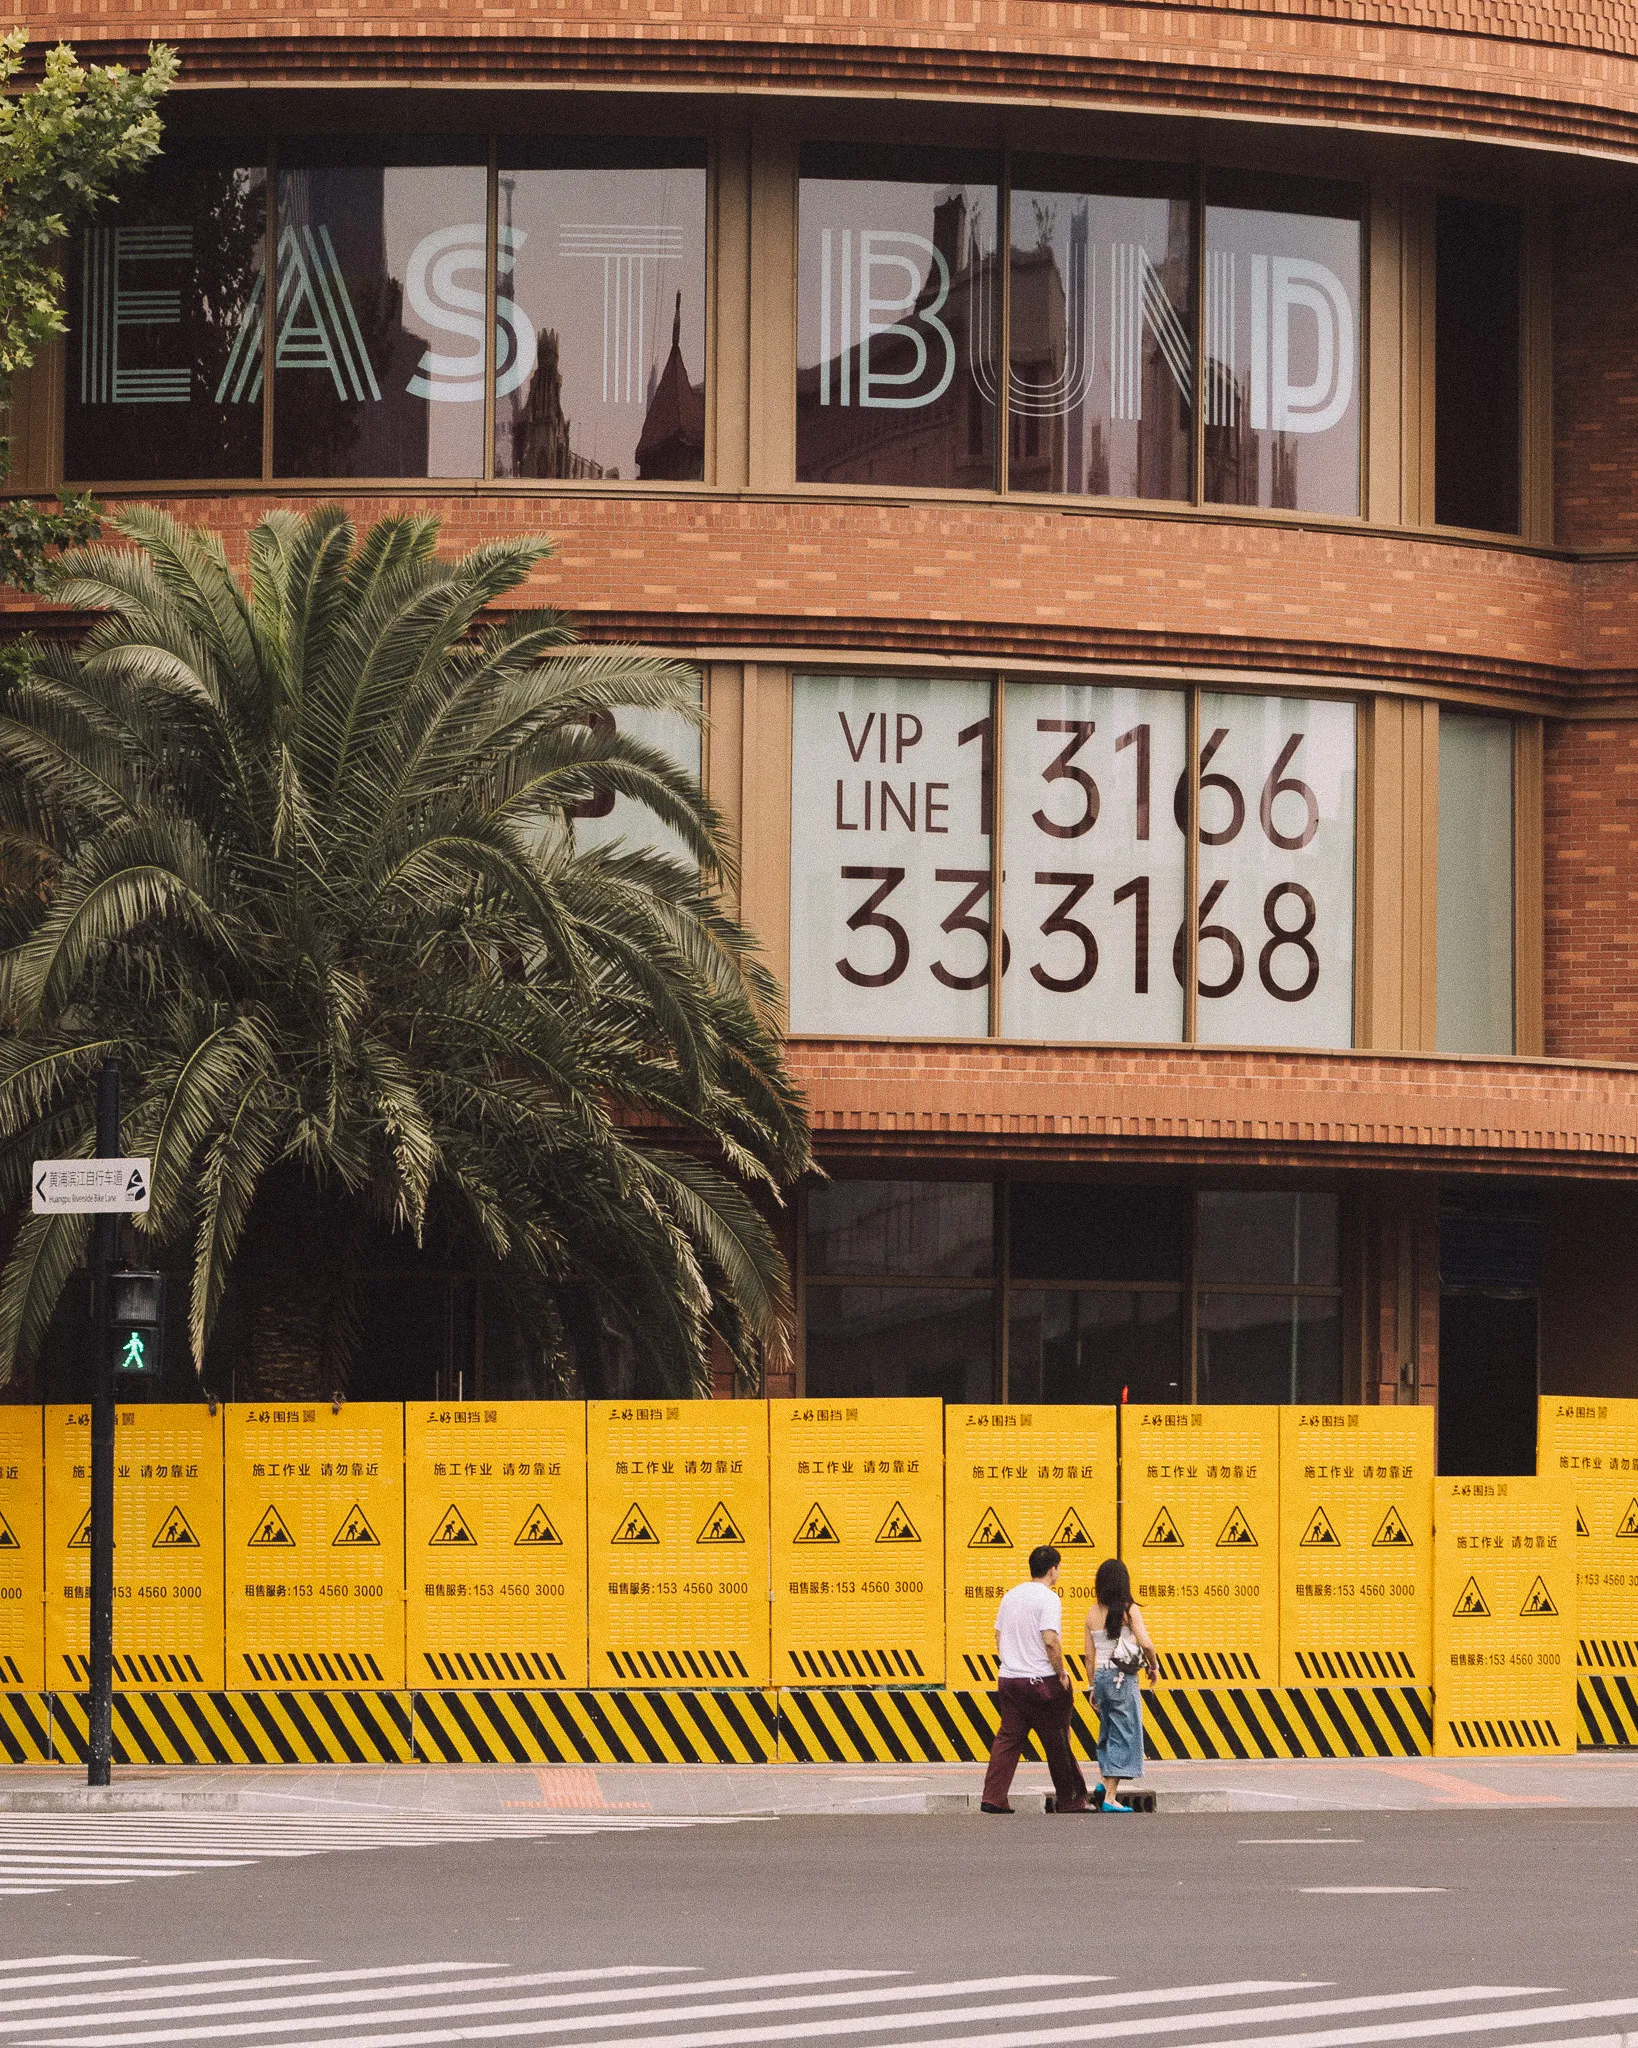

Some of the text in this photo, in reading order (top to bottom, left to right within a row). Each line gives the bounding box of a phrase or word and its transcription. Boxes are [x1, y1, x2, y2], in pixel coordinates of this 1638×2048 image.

[82, 222, 1354, 434] EAST BUND
[837, 711, 923, 763] VIP
[836, 779, 949, 834] LINE
[835, 866, 1320, 1002] 333168
[72, 1194, 94, 1203] Riverside
[94, 1194, 105, 1203] Bike
[105, 1194, 117, 1203] Lane
[64, 1413, 119, 1427] 三好
[252, 1462, 378, 1477] 施工作业 请勿靠近
[433, 1462, 561, 1476] 施工作业 请勿靠近
[615, 1460, 743, 1475] 施工作业 请勿靠近
[797, 1459, 920, 1474] 施工作业 请勿靠近
[1558, 1455, 1602, 1470] 施工作业
[72, 1464, 198, 1479] 施业 请勿靠近
[972, 1465, 1093, 1479] 施工作业 请勿靠近
[1147, 1465, 1257, 1479] 施工作业 请勿靠近
[1304, 1465, 1413, 1479] 施工作业 请勿靠近
[1457, 1535, 1557, 1549] 施工作业 请勿靠近
[860, 1581, 890, 1593] 4560
[894, 1581, 924, 1593] 3000
[1602, 1574, 1625, 1586] 4560
[136, 1586, 168, 1599] 4560
[172, 1586, 202, 1599] 3000
[318, 1584, 349, 1597] 4560
[353, 1584, 384, 1597] 3000
[499, 1584, 530, 1596] 4560
[534, 1583, 565, 1596] 3000
[682, 1582, 713, 1594] 4560
[718, 1582, 748, 1594] 3000
[1203, 1585, 1230, 1597] 4560
[1234, 1585, 1260, 1597] 3000
[1358, 1584, 1385, 1597] 4560
[1388, 1584, 1415, 1596] 3000
[1510, 1653, 1533, 1665] 4560
[1536, 1653, 1561, 1665] 3000
